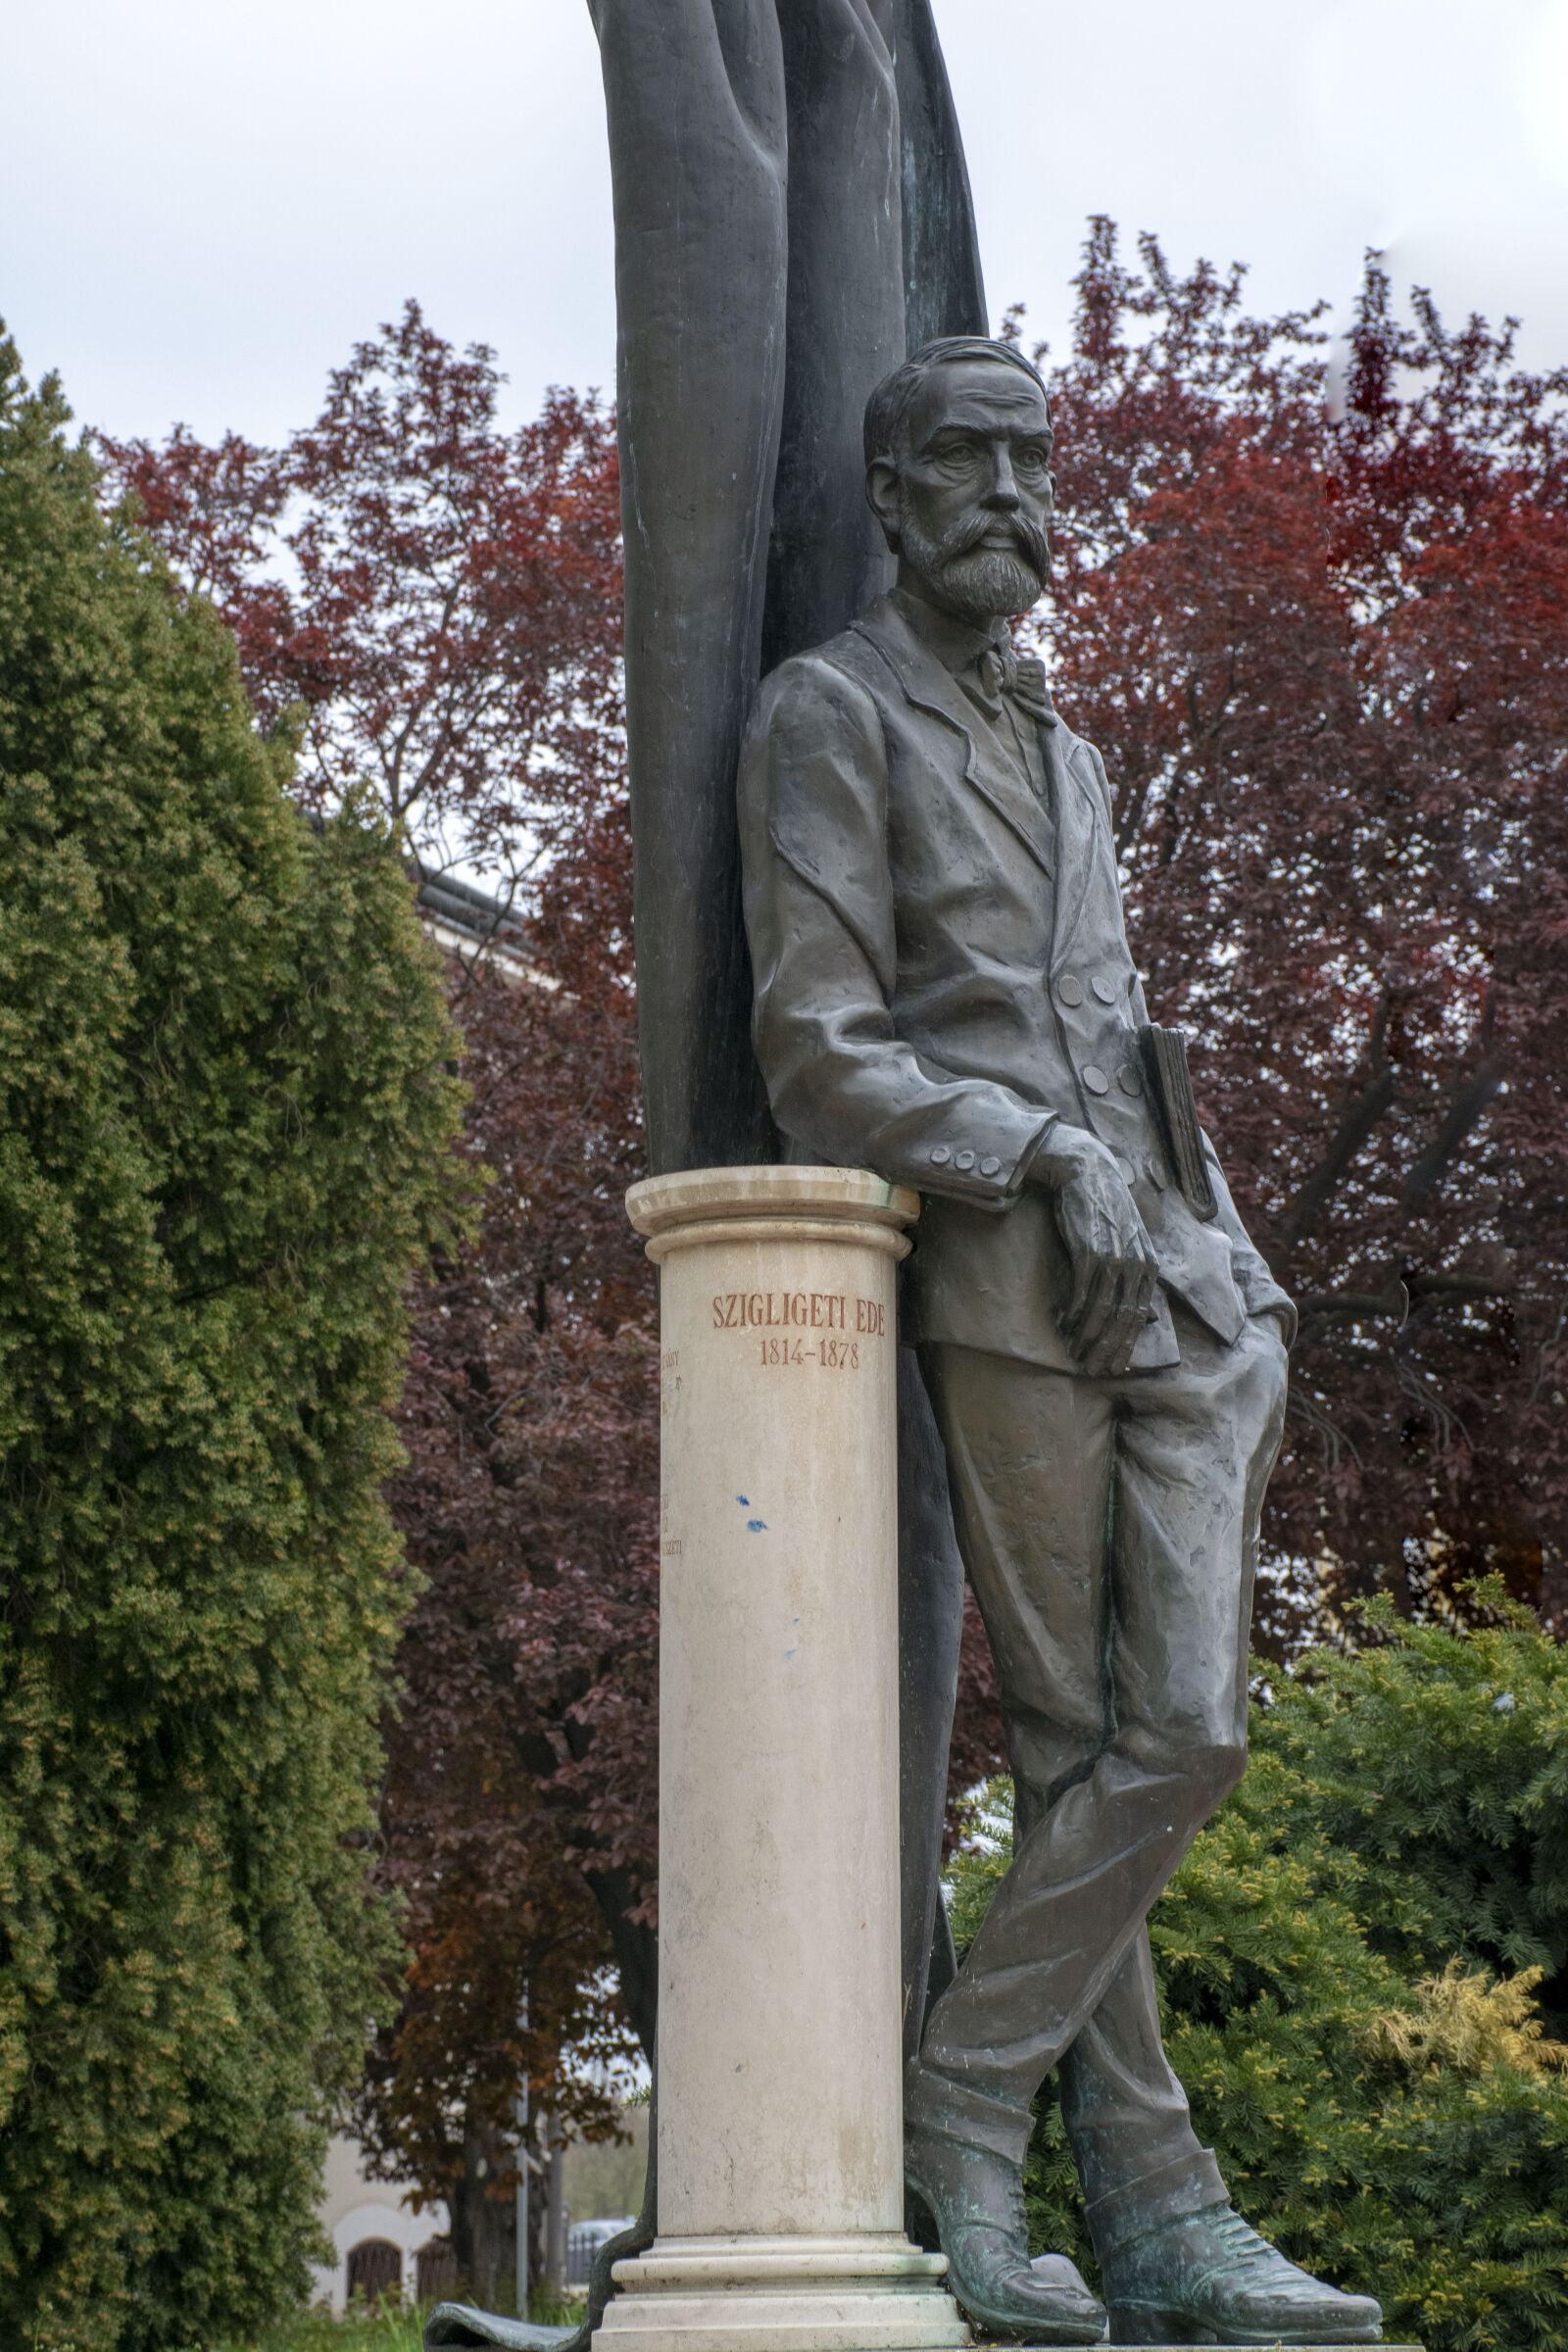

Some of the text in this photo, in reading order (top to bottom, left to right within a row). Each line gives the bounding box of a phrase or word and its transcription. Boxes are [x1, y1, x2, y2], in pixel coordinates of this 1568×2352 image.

[712, 1293, 885, 1337] SZIGLIGETI EDE
[760, 1338, 859, 1370] 1814-1878
